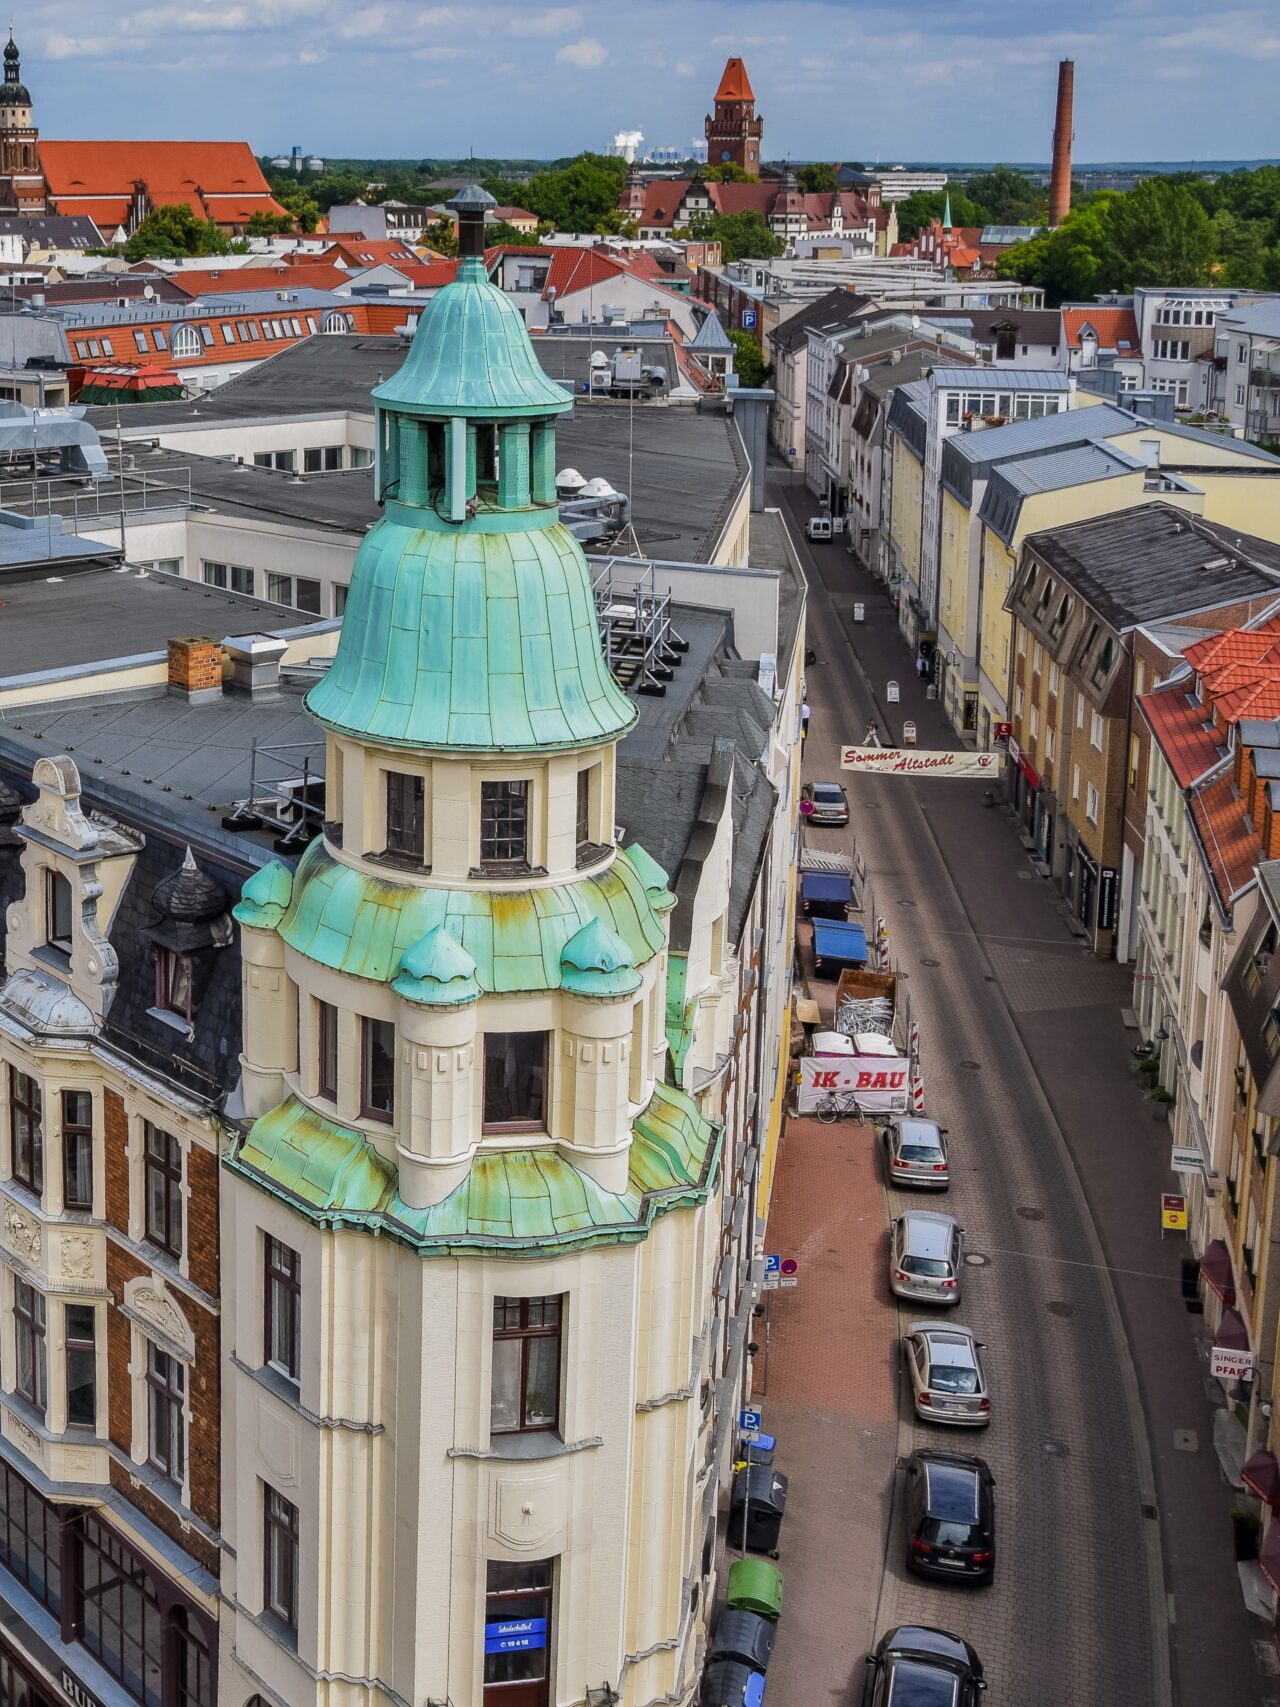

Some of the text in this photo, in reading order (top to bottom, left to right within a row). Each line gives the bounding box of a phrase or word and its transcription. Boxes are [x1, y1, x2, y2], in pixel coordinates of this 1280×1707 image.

[844, 750, 901, 763] Sommer
[892, 753, 954, 772] Altstadt
[811, 1071, 840, 1088] IK
[855, 1071, 906, 1088] BAU
[765, 1256, 775, 1270] P
[1214, 1354, 1252, 1366] SINGER
[744, 1413, 755, 1428] P
